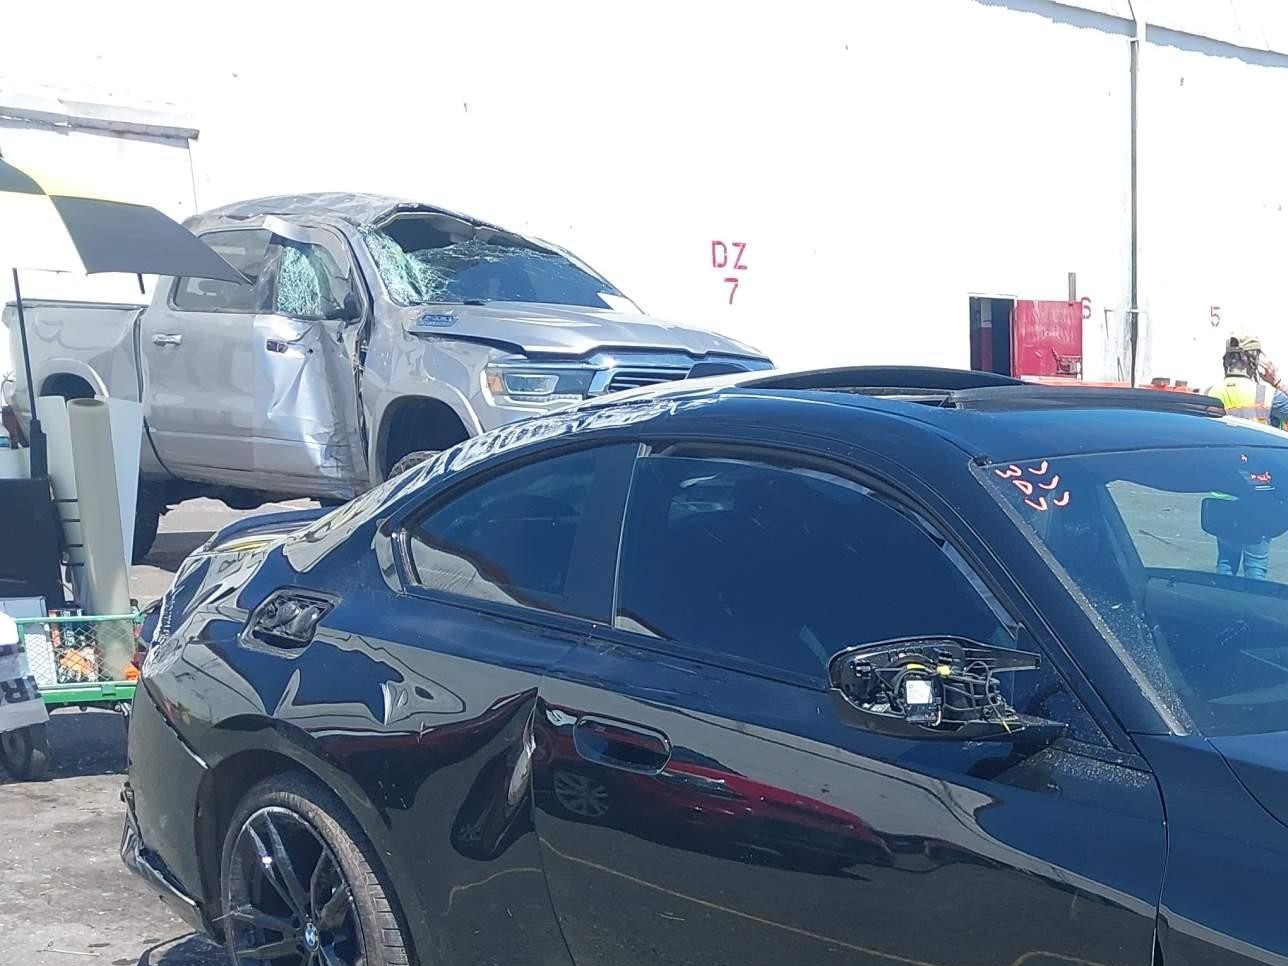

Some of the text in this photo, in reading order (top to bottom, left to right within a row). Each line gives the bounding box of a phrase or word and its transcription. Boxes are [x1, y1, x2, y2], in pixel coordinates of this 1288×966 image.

[711, 240, 748, 270] DZ
[724, 277, 739, 305] 7
[1080, 296, 1092, 319] 6
[1210, 305, 1221, 327] 5
